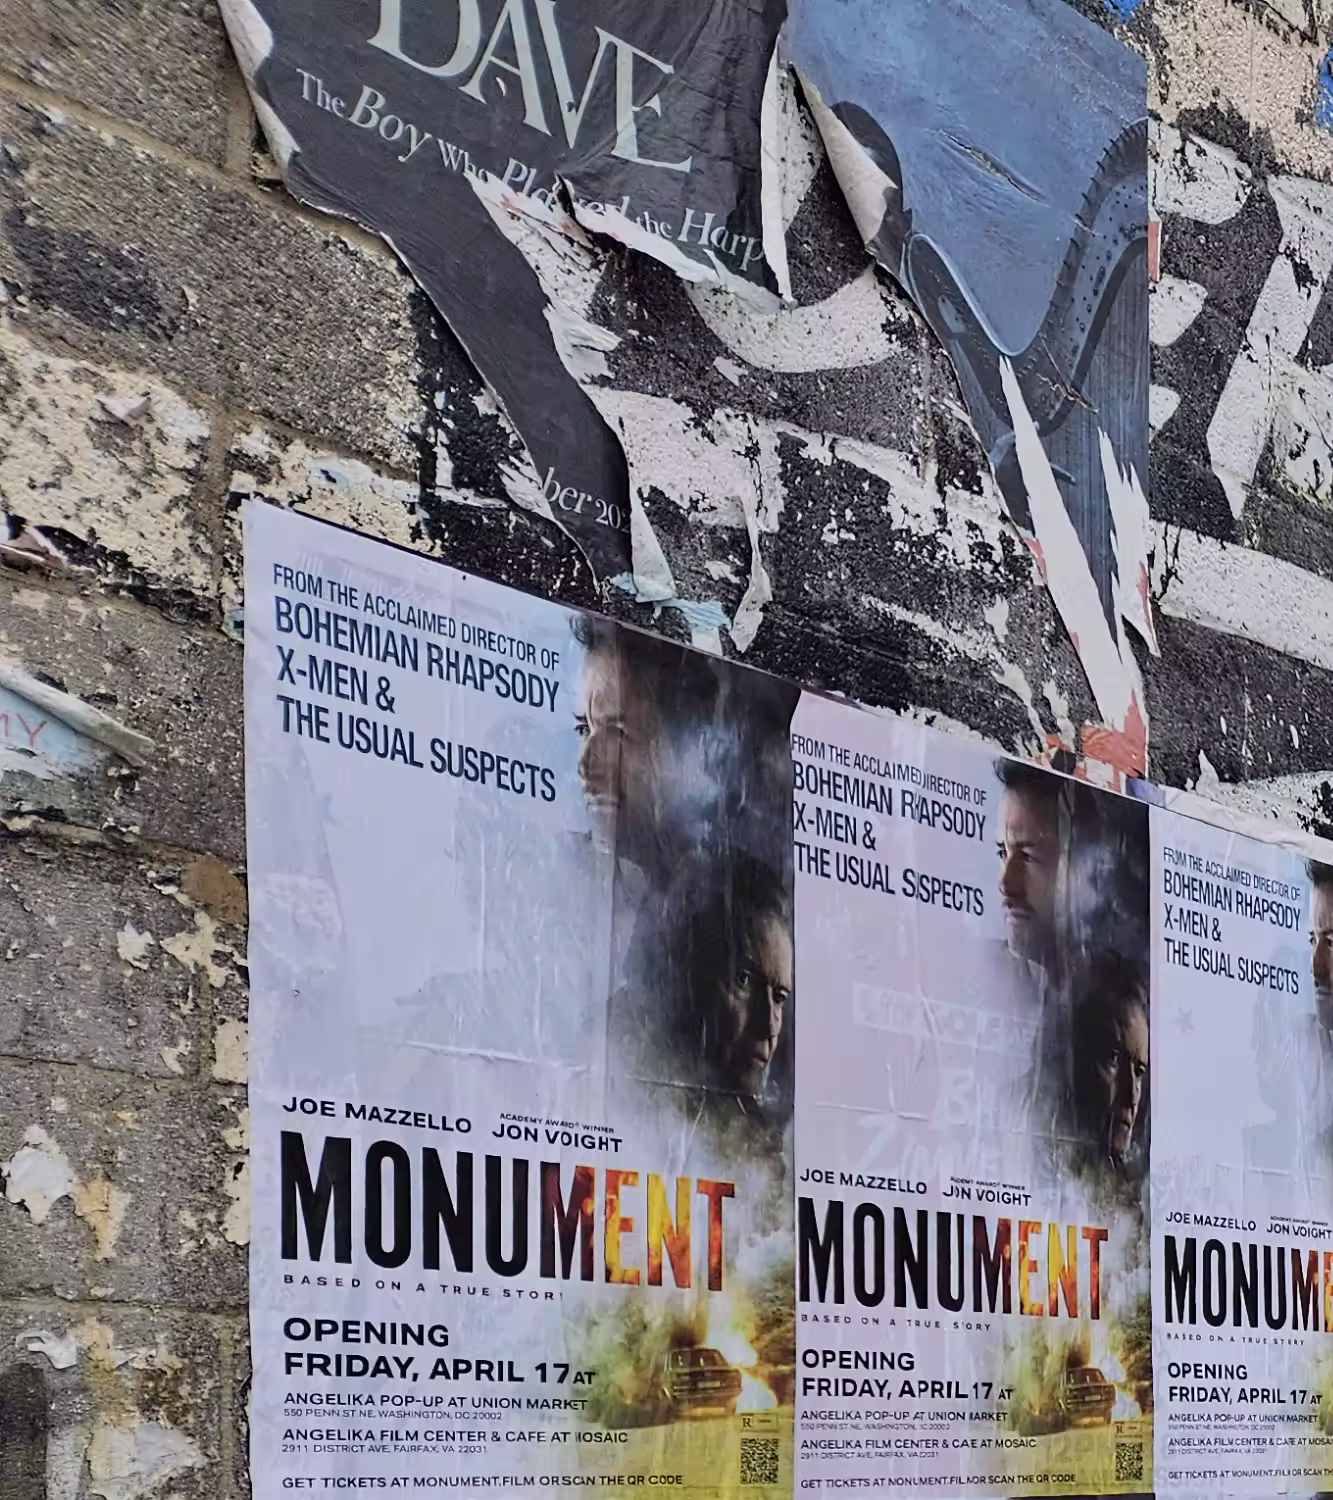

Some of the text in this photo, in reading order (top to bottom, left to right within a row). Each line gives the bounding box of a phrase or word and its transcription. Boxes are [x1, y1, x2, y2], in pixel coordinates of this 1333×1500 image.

[366, 0, 692, 172] DAVE
[296, 69, 347, 122] The
[349, 84, 427, 163] Boy
[436, 137, 490, 182] Who
[677, 209, 764, 272] Harp
[543, 468, 630, 536] ber 202
[273, 563, 560, 671] FROM THE ACCLAIMED DIRECTOR OF
[275, 595, 560, 713] BOHEMIAN RHAPSODY
[277, 645, 396, 715] X-MEN &
[277, 695, 556, 802] THE USUAL SUSPECTS
[1163, 869, 1301, 932] BOHEMIAN RHAPSODY
[283, 1096, 472, 1134] JOE MAZZELLO
[500, 1113, 542, 1124] ACADEMY
[492, 1123, 623, 1153] JON VOIGHT
[800, 1168, 927, 1196] JOE MAZZELLO
[281, 1130, 736, 1291] MONUMENT
[798, 1196, 1109, 1321] MONUMENT
[283, 1274, 361, 1288] BASED
[375, 1281, 401, 1291] ON
[416, 1283, 426, 1292] A
[440, 1284, 490, 1296] TRUE
[283, 1317, 449, 1347] OPENING
[284, 1352, 596, 1385] FRIDAY, APRIL 17 AT
[802, 1349, 915, 1371] OPENING
[284, 1393, 588, 1411] ANGELIKA POP-UP AT UNION MARKET
[802, 1377, 993, 1400] FRIDAY, APRIL 17
[284, 1408, 303, 1417] 550
[305, 1408, 340, 1418] PENN
[343, 1409, 357, 1417] ST
[455, 1411, 470, 1420] DC
[472, 1412, 502, 1420] 20002
[281, 1444, 308, 1453] 2911
[313, 1444, 366, 1453] DISTRICT
[442, 1445, 455, 1453] VA
[282, 1428, 375, 1441] ANGELIKA
[380, 1430, 419, 1442] FILM
[423, 1430, 486, 1442] CENTER
[490, 1431, 501, 1442] &
[505, 1431, 546, 1443] CAFE
[551, 1431, 571, 1443] AT
[282, 1477, 316, 1489] GET
[320, 1477, 387, 1489] TICKETS
[390, 1477, 410, 1488] AT
[413, 1475, 534, 1488] MONUMENT.FILM
[539, 1476, 561, 1486] OR
[600, 1475, 624, 1486] THE
[627, 1475, 645, 1486] QR
[648, 1475, 683, 1486] CODE
